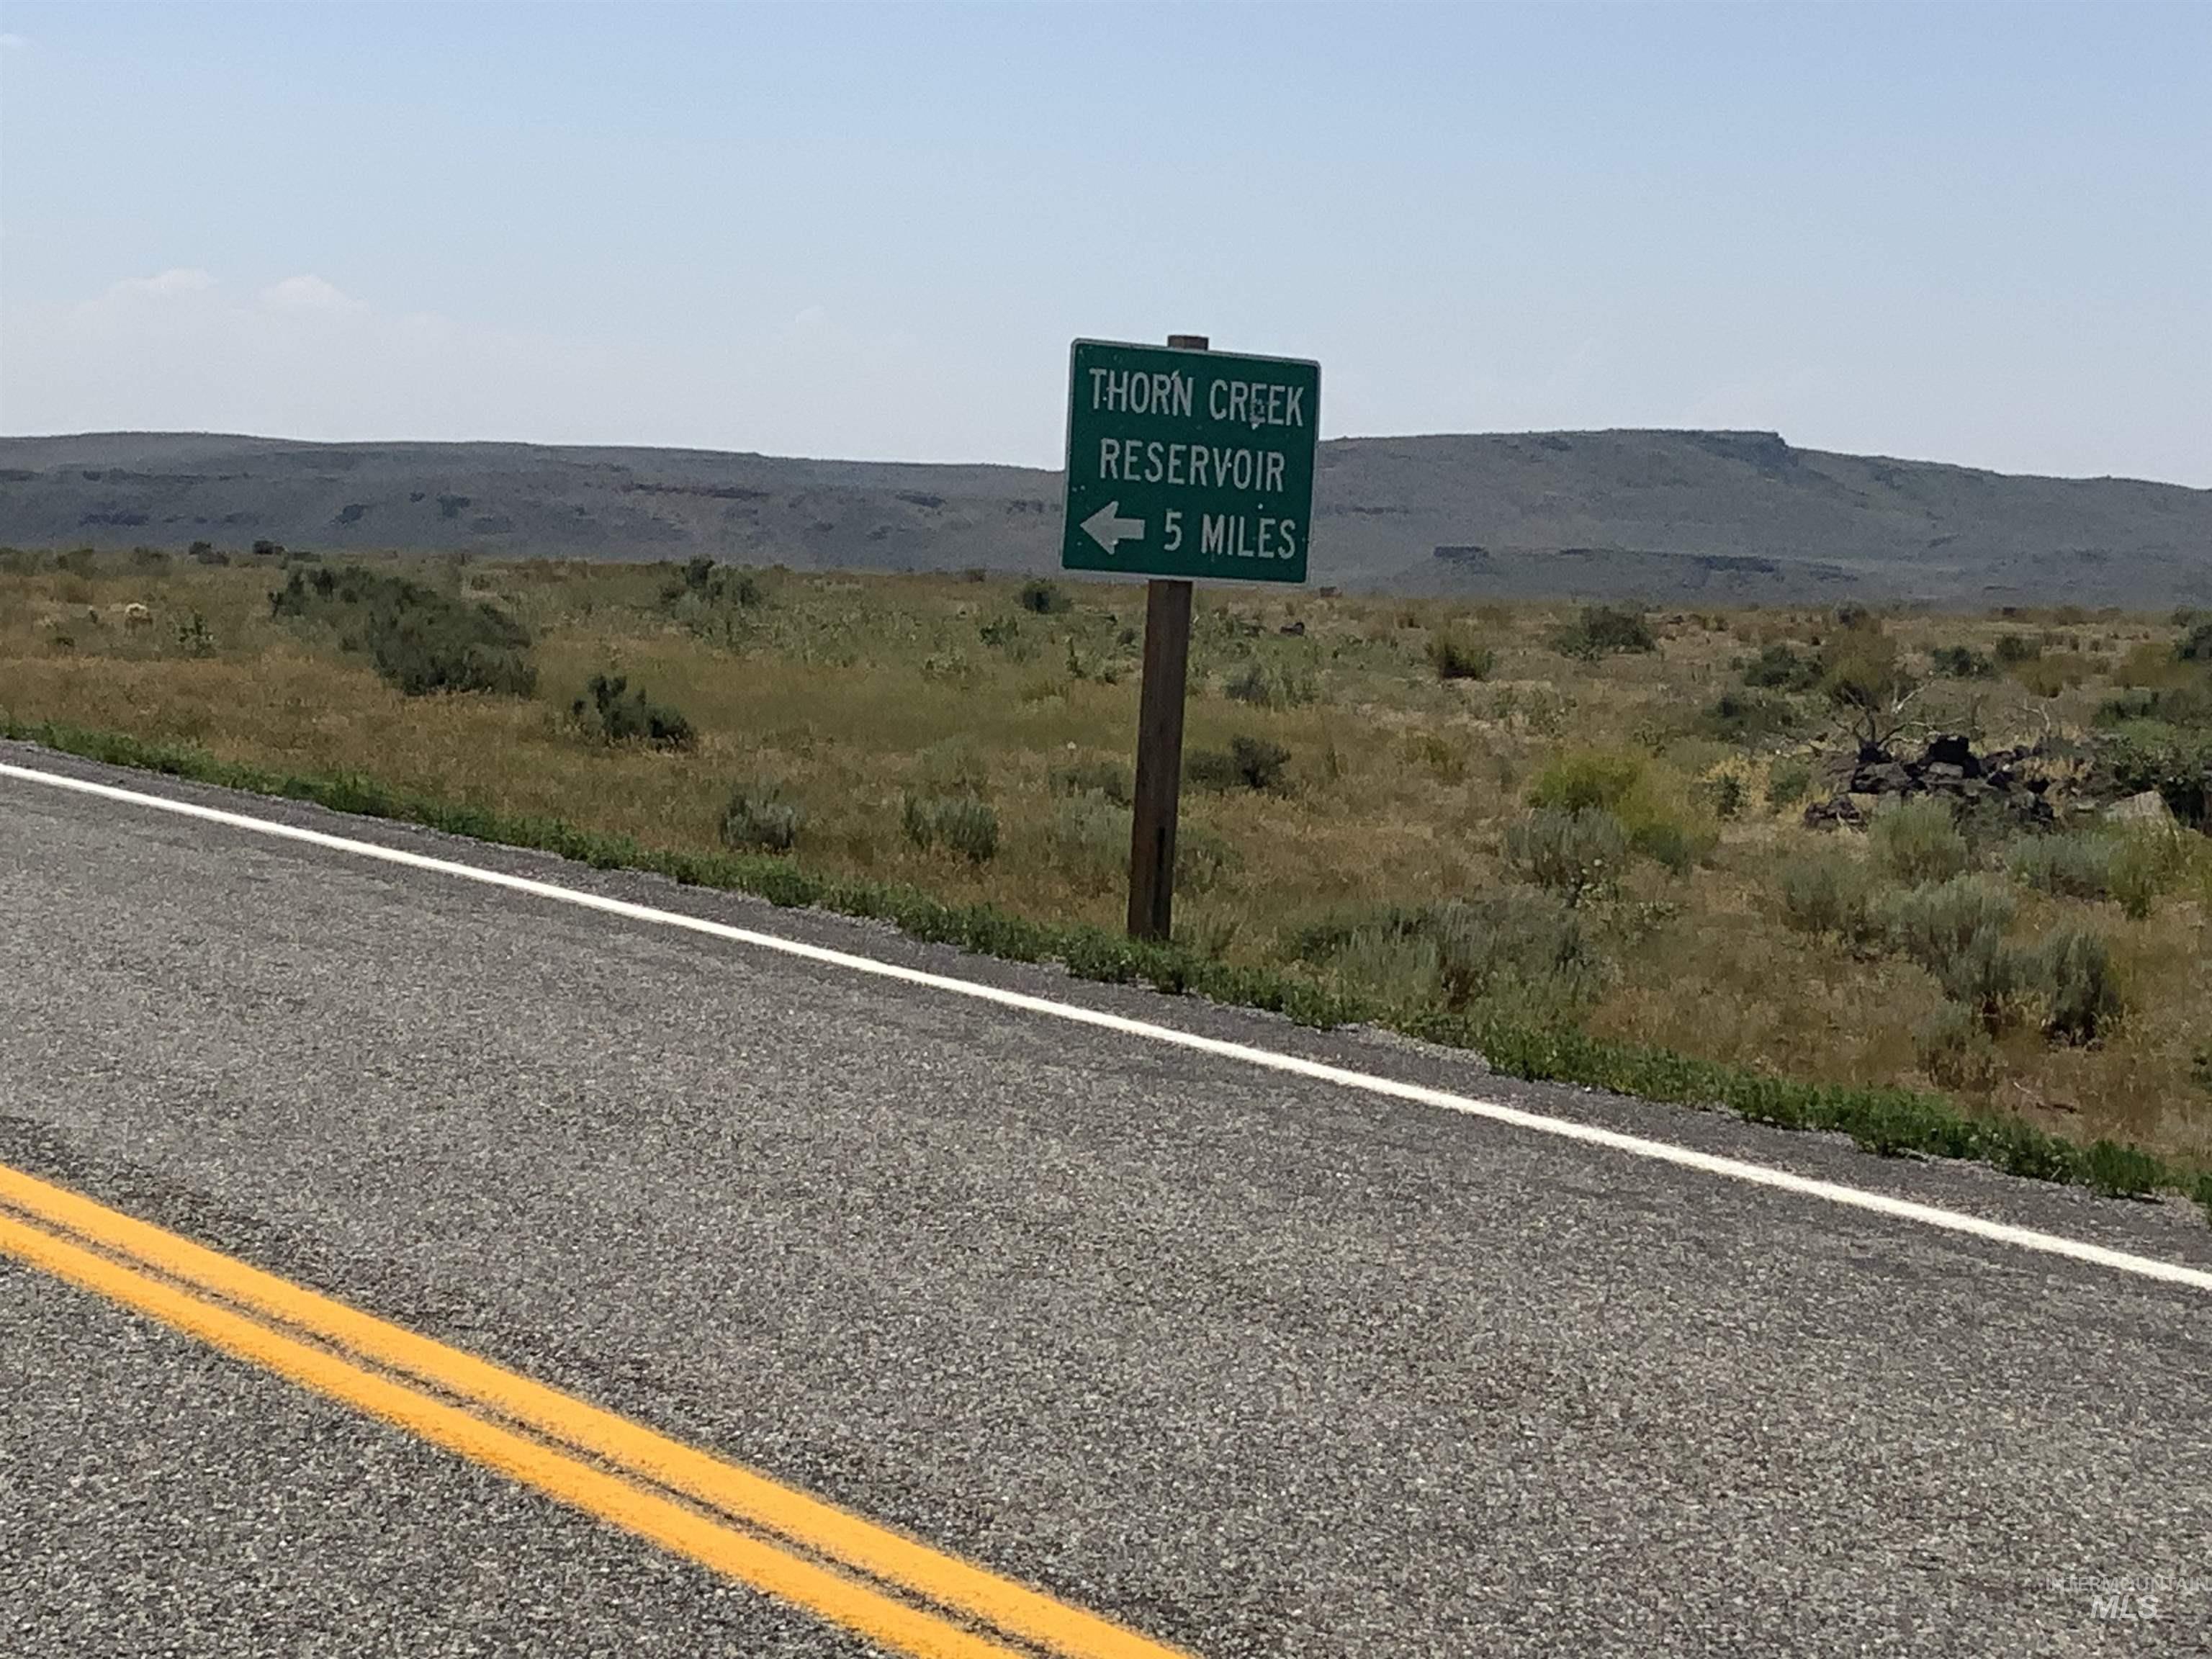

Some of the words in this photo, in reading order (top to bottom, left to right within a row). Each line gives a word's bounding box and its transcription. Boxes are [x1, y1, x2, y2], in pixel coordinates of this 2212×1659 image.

[1089, 368, 1193, 417] THORN
[1210, 379, 1304, 427] CREEK
[1100, 437, 1285, 492] RESERVOIR
[1164, 511, 1182, 551] 5
[1200, 513, 1295, 559] MILES
